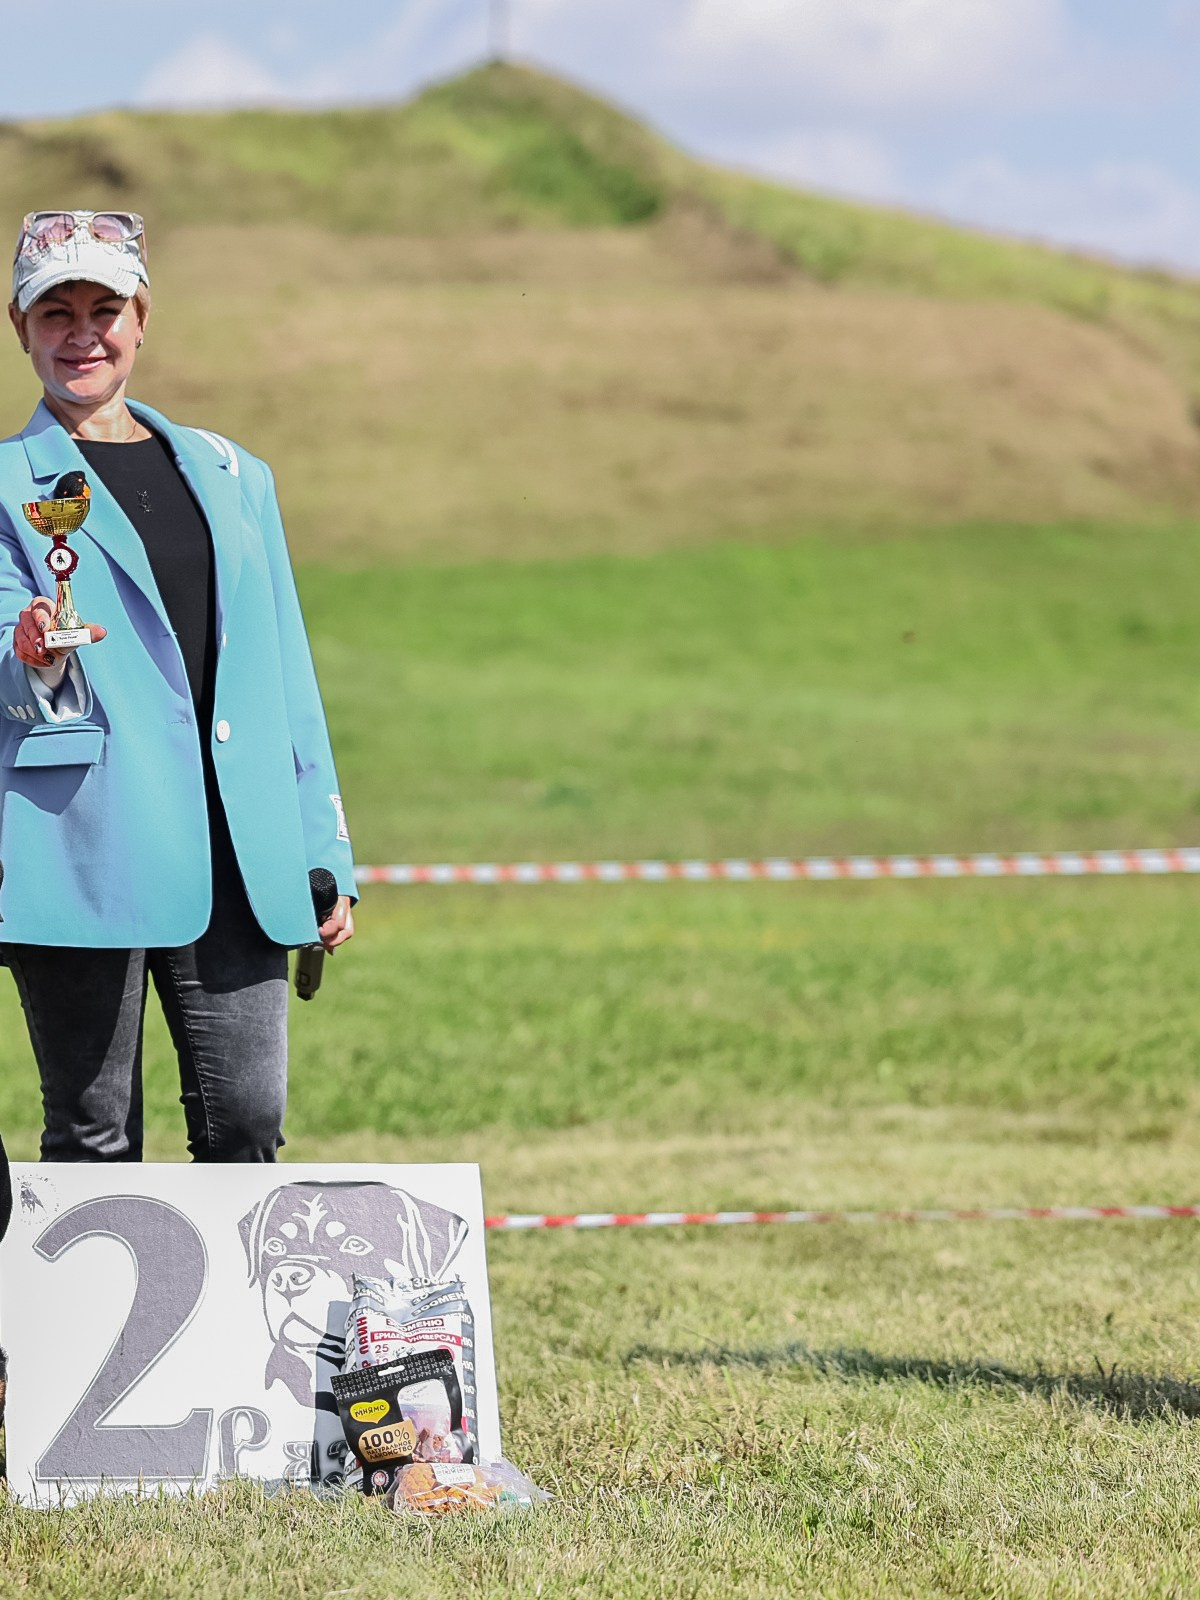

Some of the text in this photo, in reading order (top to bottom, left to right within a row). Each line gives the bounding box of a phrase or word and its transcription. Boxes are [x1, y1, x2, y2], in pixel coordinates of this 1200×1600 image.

[412, 1291, 465, 1316] ЗООМЕН
[33, 1194, 213, 1481] 2
[408, 1333, 457, 1343] УНИВЕРСАЛ
[375, 1343, 389, 1354] 25
[362, 1427, 410, 1450] 100%
[366, 1440, 412, 1455] НАТУРАЛЬНОЕ
[370, 1445, 413, 1459] ЛАКОМСТВО
